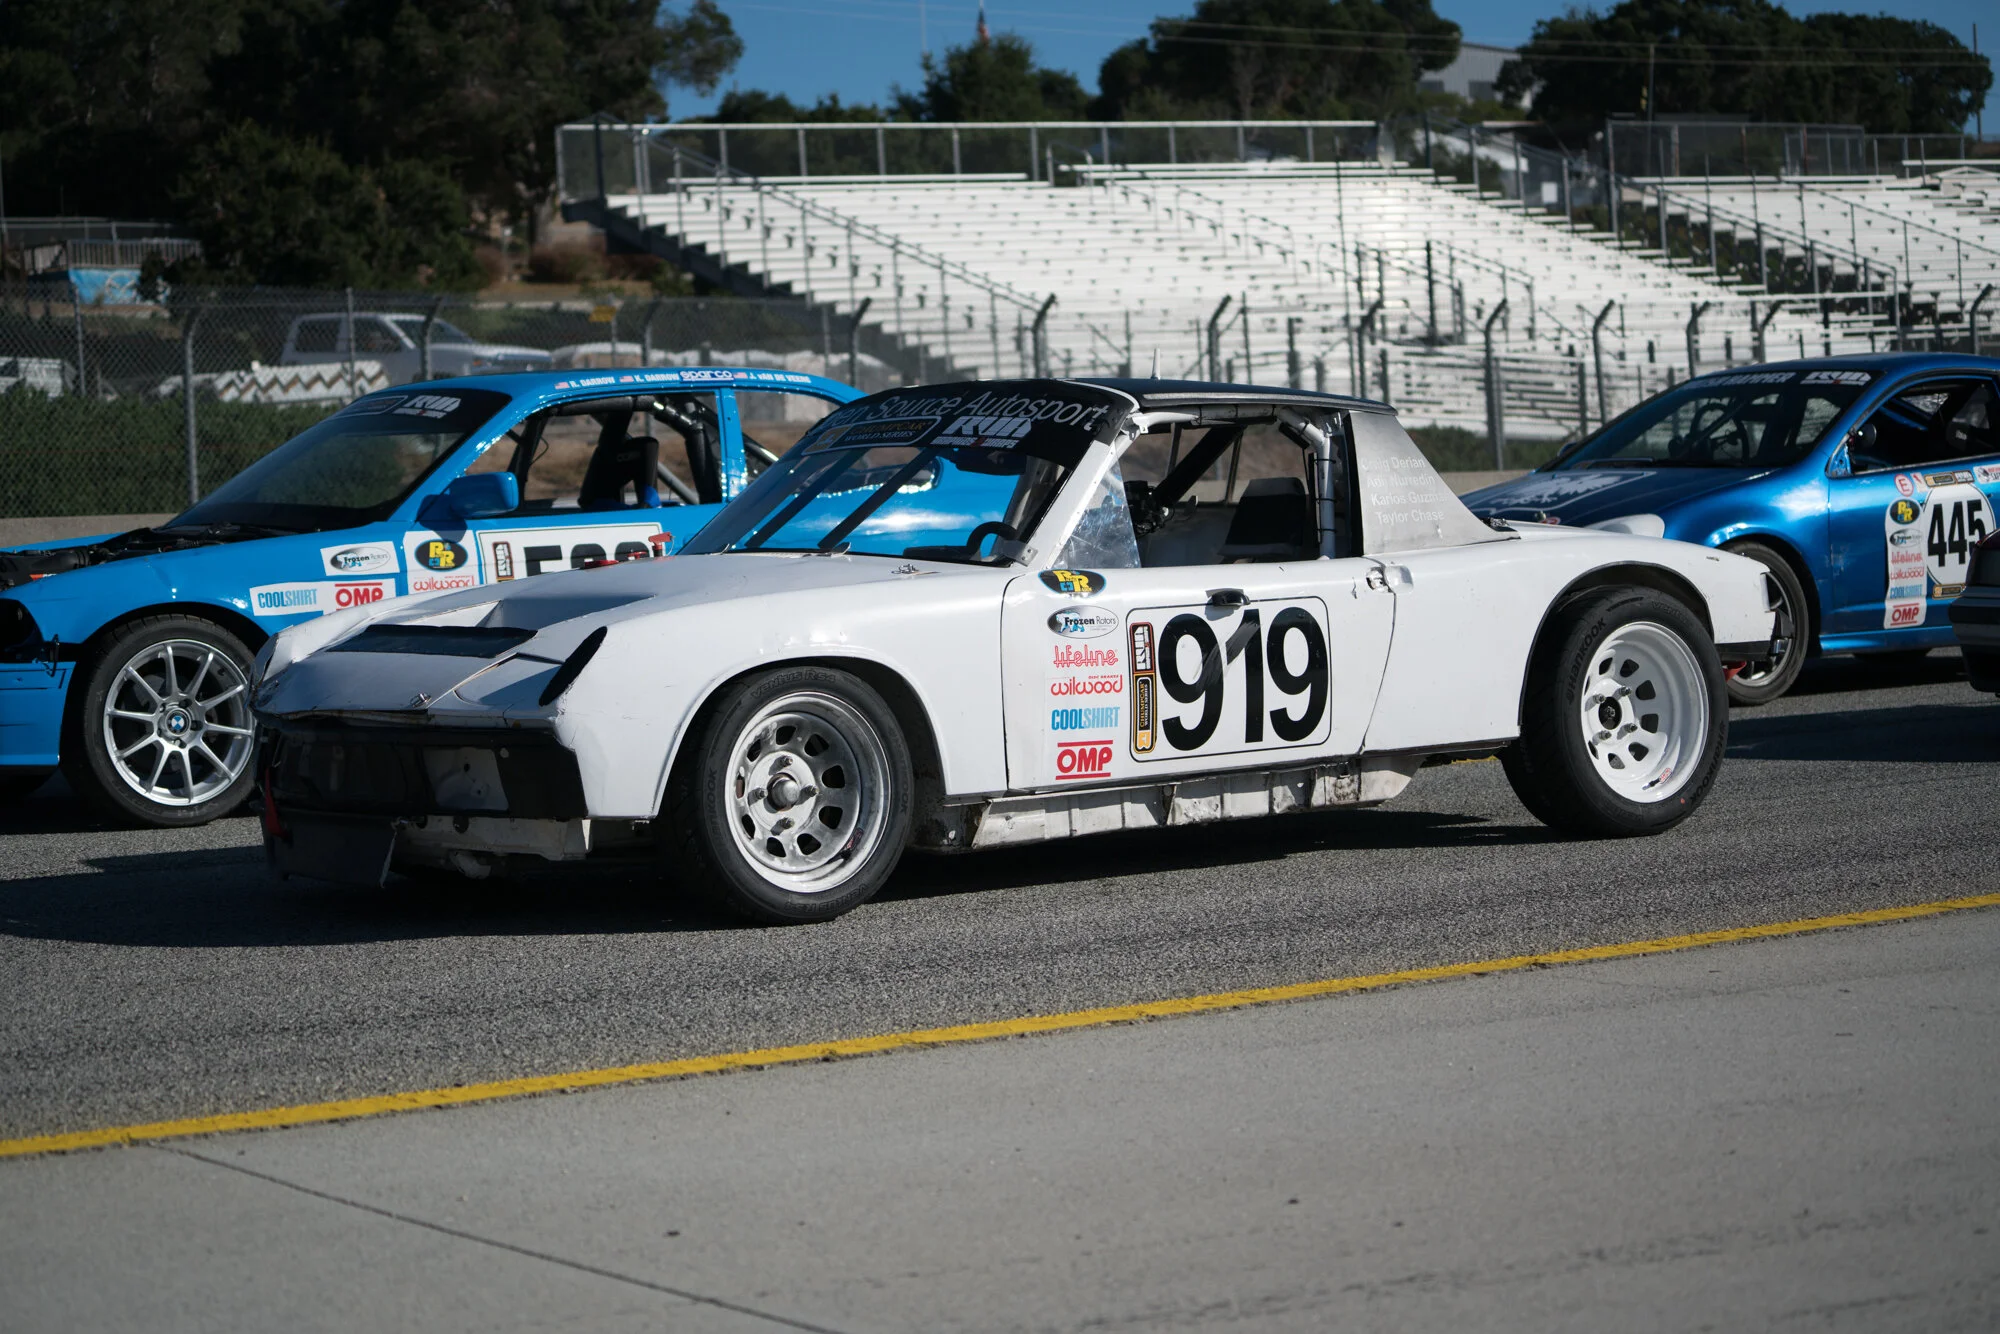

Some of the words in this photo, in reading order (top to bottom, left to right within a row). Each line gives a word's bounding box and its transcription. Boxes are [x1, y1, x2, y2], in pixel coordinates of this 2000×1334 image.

[680, 369, 733, 380] sparco
[866, 395, 954, 421] Source
[956, 391, 1109, 431] Autosport
[1391, 456, 1426, 469] Derian
[1407, 491, 1448, 504] Guzm
[1375, 510, 1409, 526] Taylor
[1410, 509, 1446, 521] Chase
[1927, 499, 1987, 568] 445
[344, 555, 370, 565] Frozen
[257, 588, 318, 609] COOLSHIRT
[335, 587, 384, 607] OMP
[1065, 616, 1095, 626] Frozen
[1096, 615, 1117, 625] Rotors
[1891, 607, 1920, 622] OMP
[1050, 674, 1124, 696] wilwood
[1157, 606, 1329, 752] 919
[1051, 706, 1121, 731] COOLSHIRT
[1056, 746, 1113, 774] OMP
